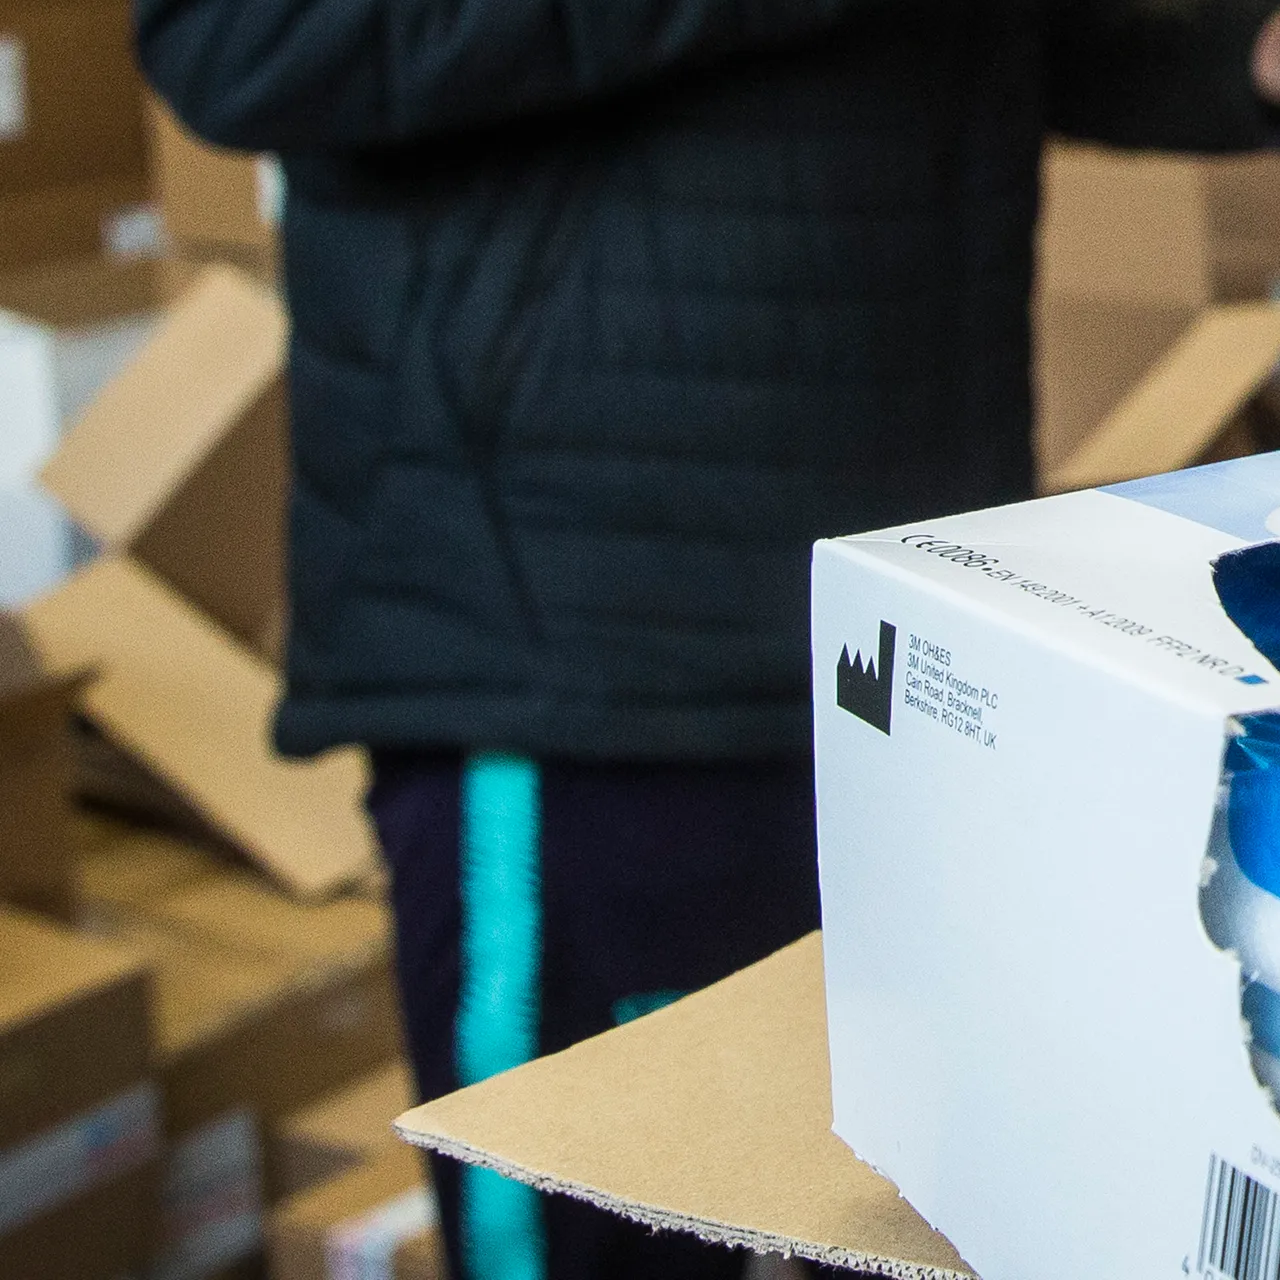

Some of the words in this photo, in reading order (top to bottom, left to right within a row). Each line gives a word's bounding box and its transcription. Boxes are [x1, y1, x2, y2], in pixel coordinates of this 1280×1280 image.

[908, 633, 921, 651] 3M
[922, 640, 951, 666] OH&ES
[905, 670, 922, 691] Cain
[907, 652, 920, 671] 3M
[920, 659, 945, 683] United
[945, 671, 979, 701] Kingdom
[980, 688, 998, 709] PLC
[941, 708, 963, 733] RG12
[984, 730, 997, 750] UK
